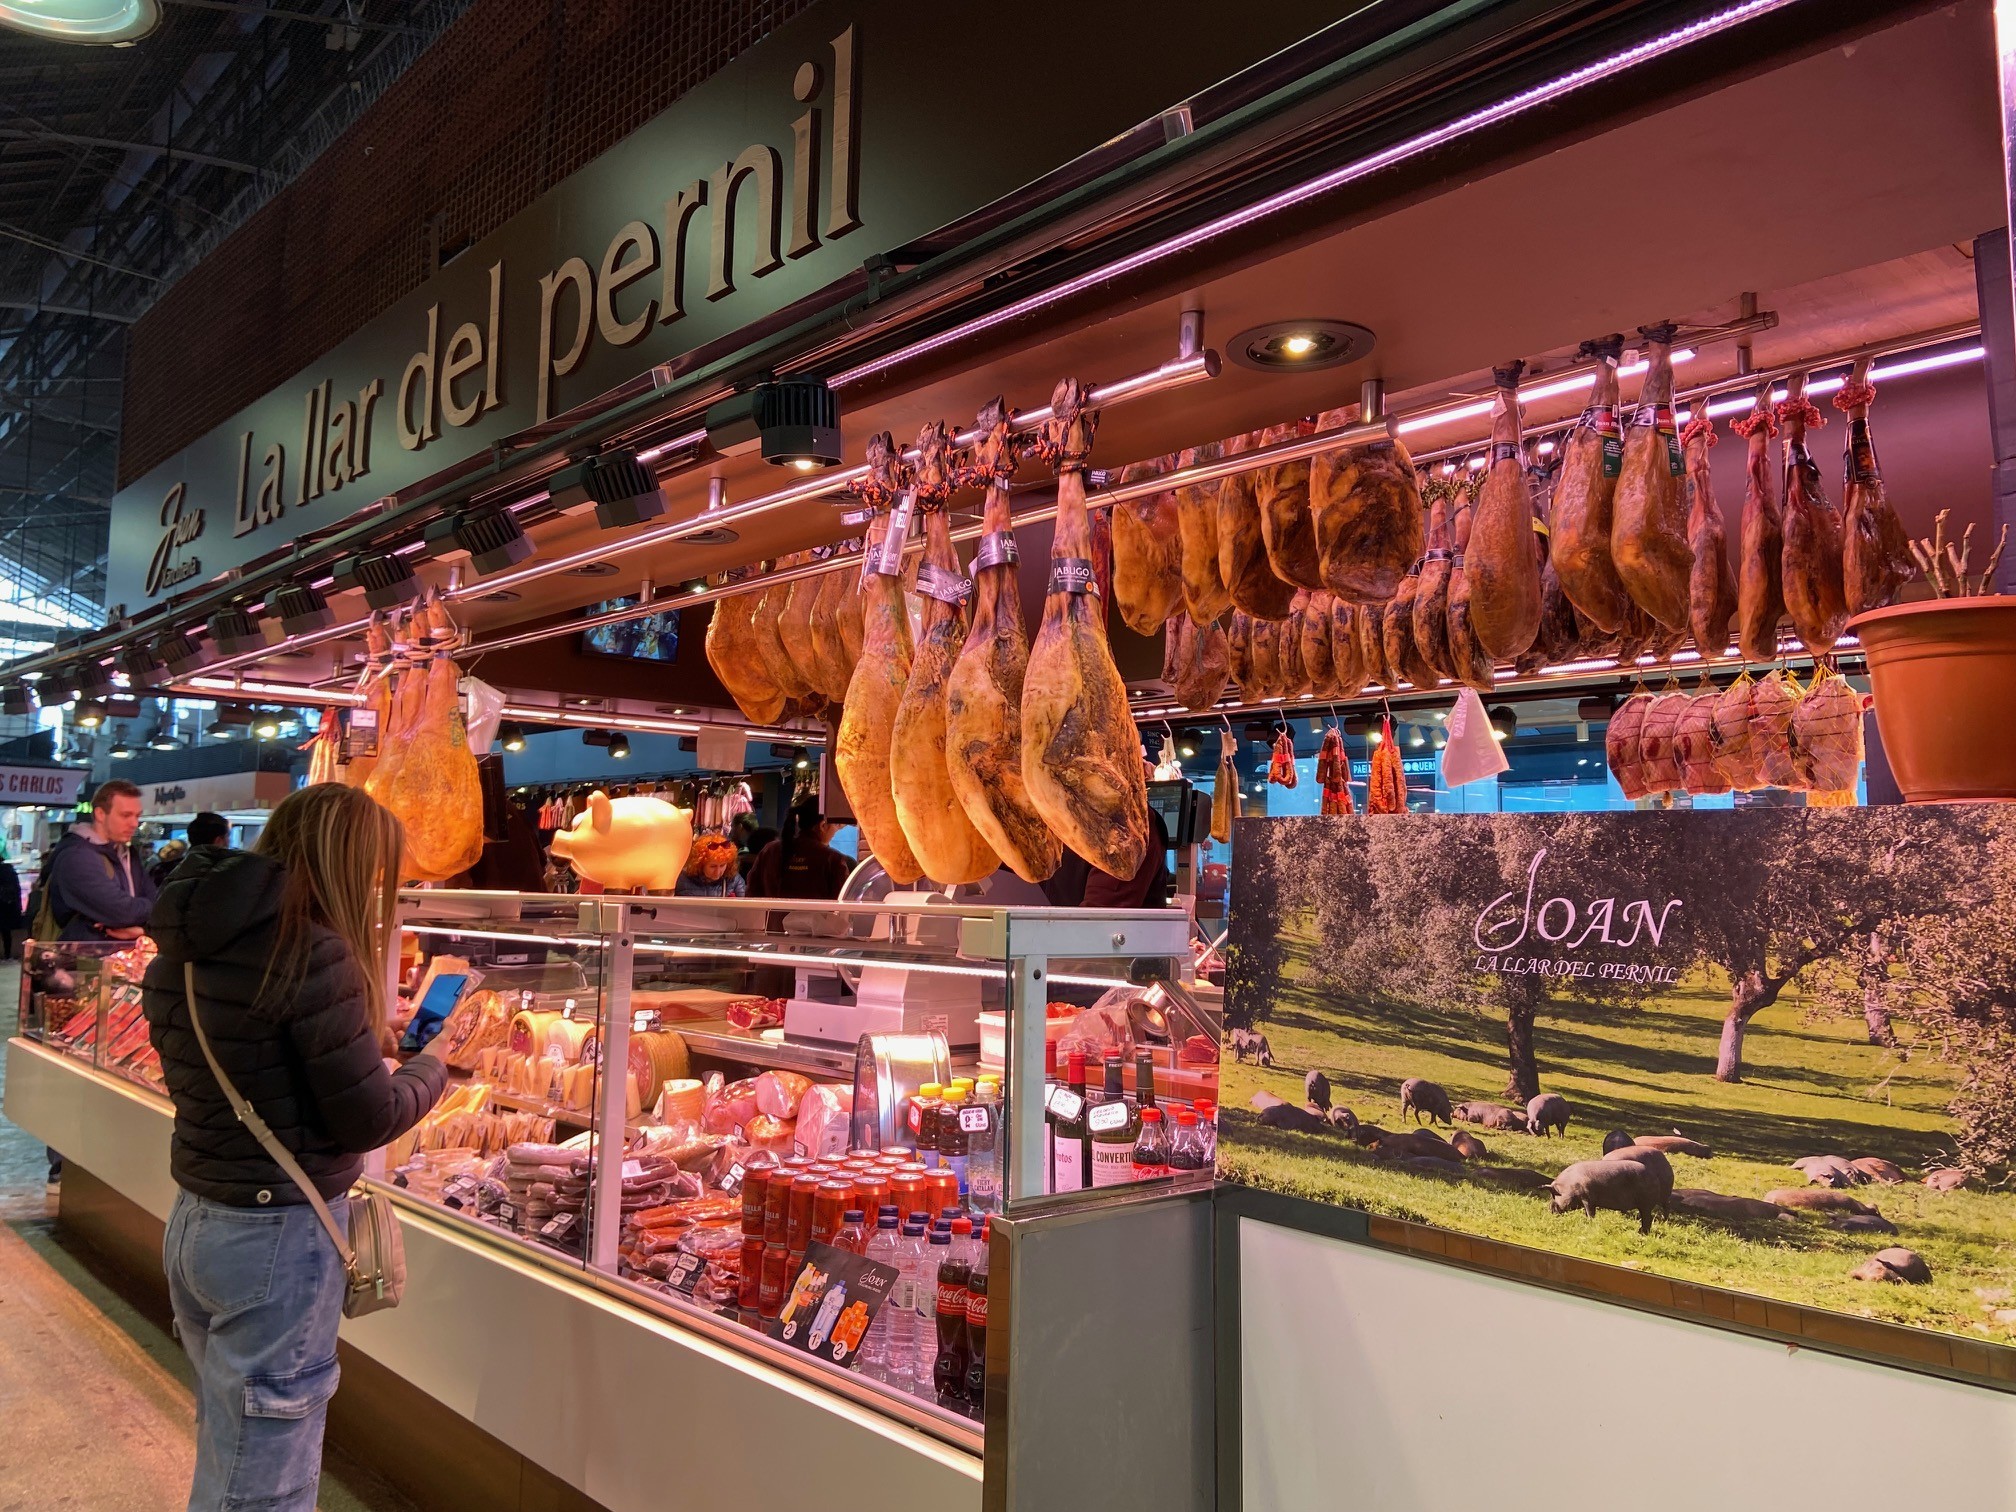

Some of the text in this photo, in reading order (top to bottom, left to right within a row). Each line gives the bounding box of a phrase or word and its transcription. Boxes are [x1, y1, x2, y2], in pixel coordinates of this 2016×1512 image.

[233, 22, 863, 538] La llar del pernil
[1001, 538, 1017, 549] JABU
[1054, 567, 1090, 577] JABUGO
[940, 578, 972, 598] JABUGO
[9, 774, 64, 794] CARLOS
[1474, 849, 1683, 952] JOAN
[1474, 955, 1498, 972] LA
[1599, 962, 1680, 984] PERNIL
[1096, 1150, 1132, 1163] CONVERTI
[938, 1285, 968, 1304] Coca-Co
